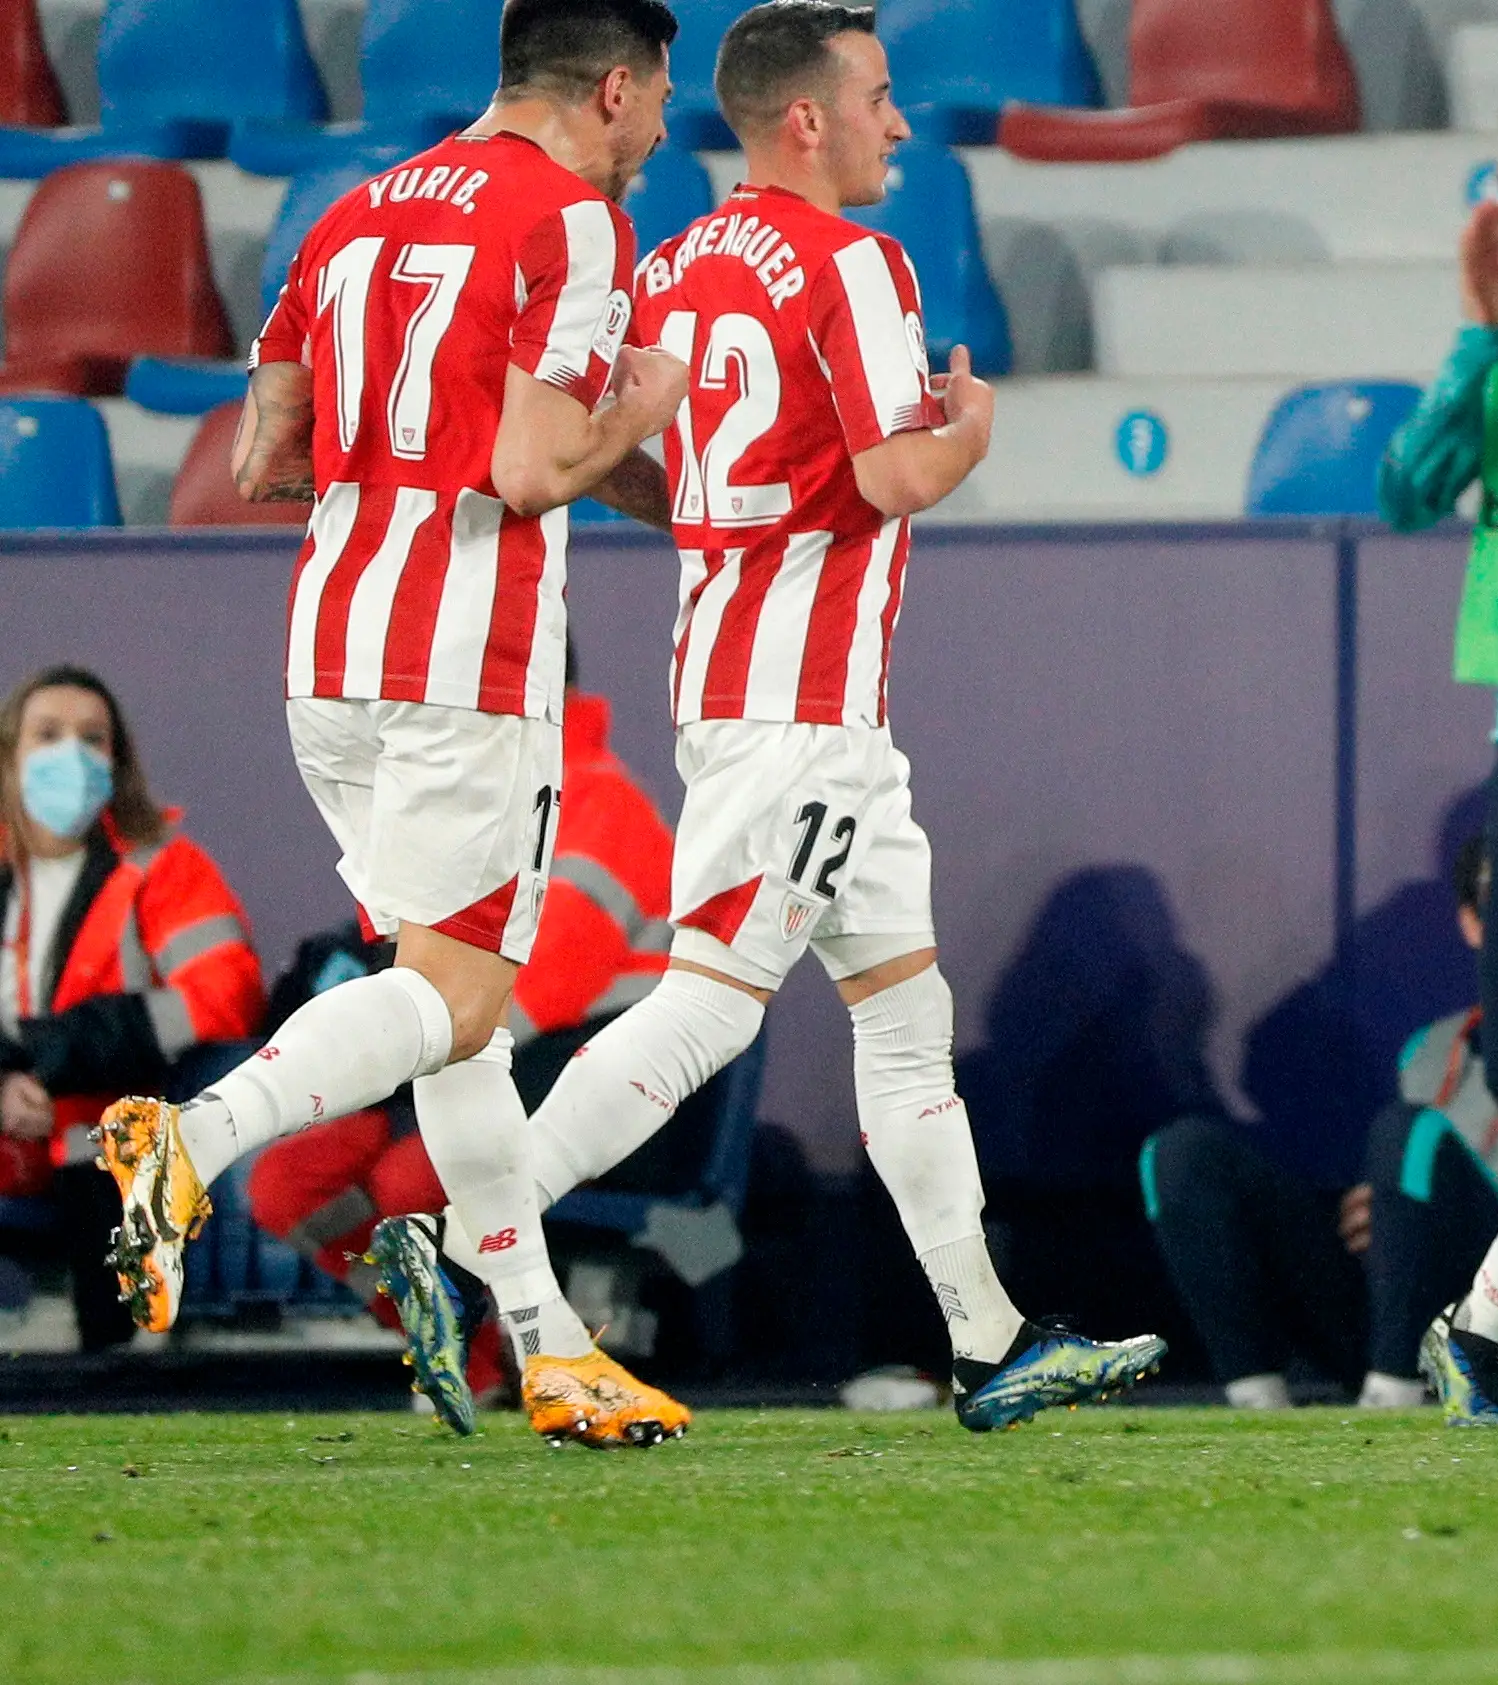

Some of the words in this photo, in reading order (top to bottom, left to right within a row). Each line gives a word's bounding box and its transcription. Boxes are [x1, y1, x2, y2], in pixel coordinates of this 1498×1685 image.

[368, 165, 467, 209] YURI
[450, 169, 489, 215] B.
[645, 212, 806, 311] BERENGUER
[316, 235, 477, 461] 17
[660, 309, 793, 529] 12
[531, 784, 562, 873] 1
[786, 800, 857, 900] 12
